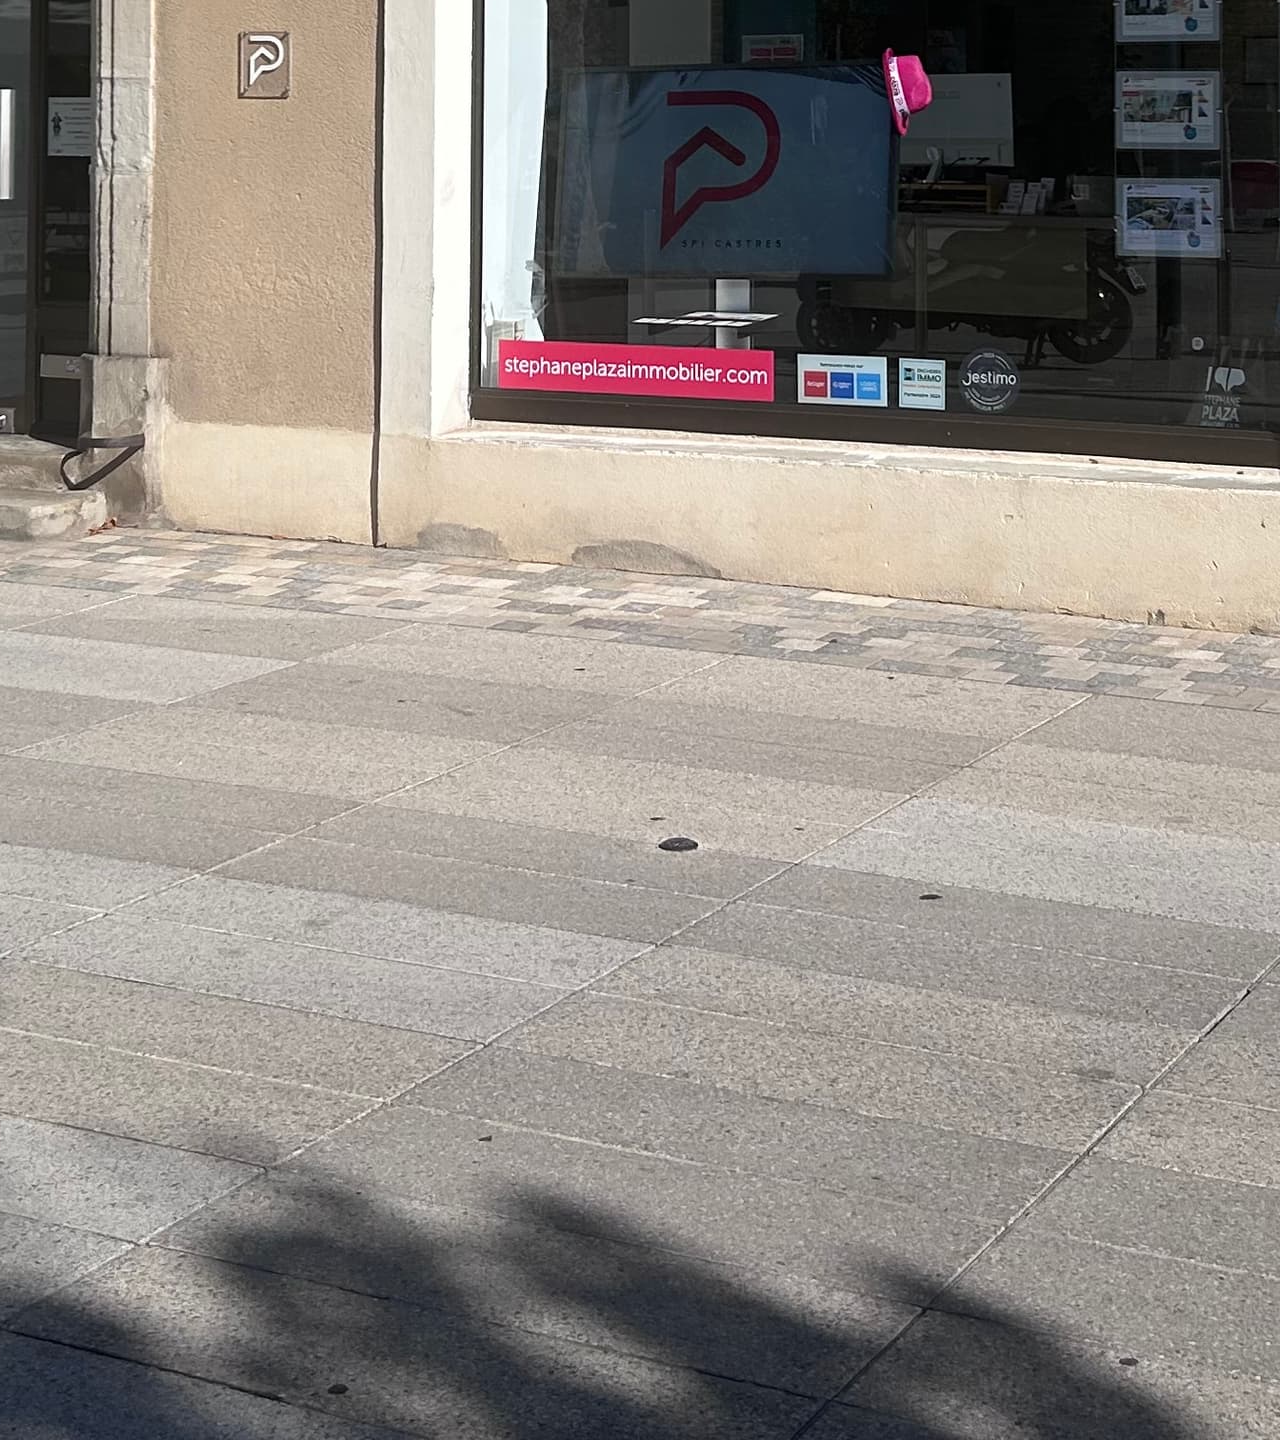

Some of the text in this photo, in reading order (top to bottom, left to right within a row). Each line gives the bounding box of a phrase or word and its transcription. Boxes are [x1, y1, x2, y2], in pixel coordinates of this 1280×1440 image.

[713, 239, 783, 249] CASTRES
[504, 357, 769, 387] stephaneplazaimmobilier.com
[916, 373, 942, 383] IMMO
[961, 369, 1017, 386] jestimo
[1201, 405, 1241, 422] PLAZA
